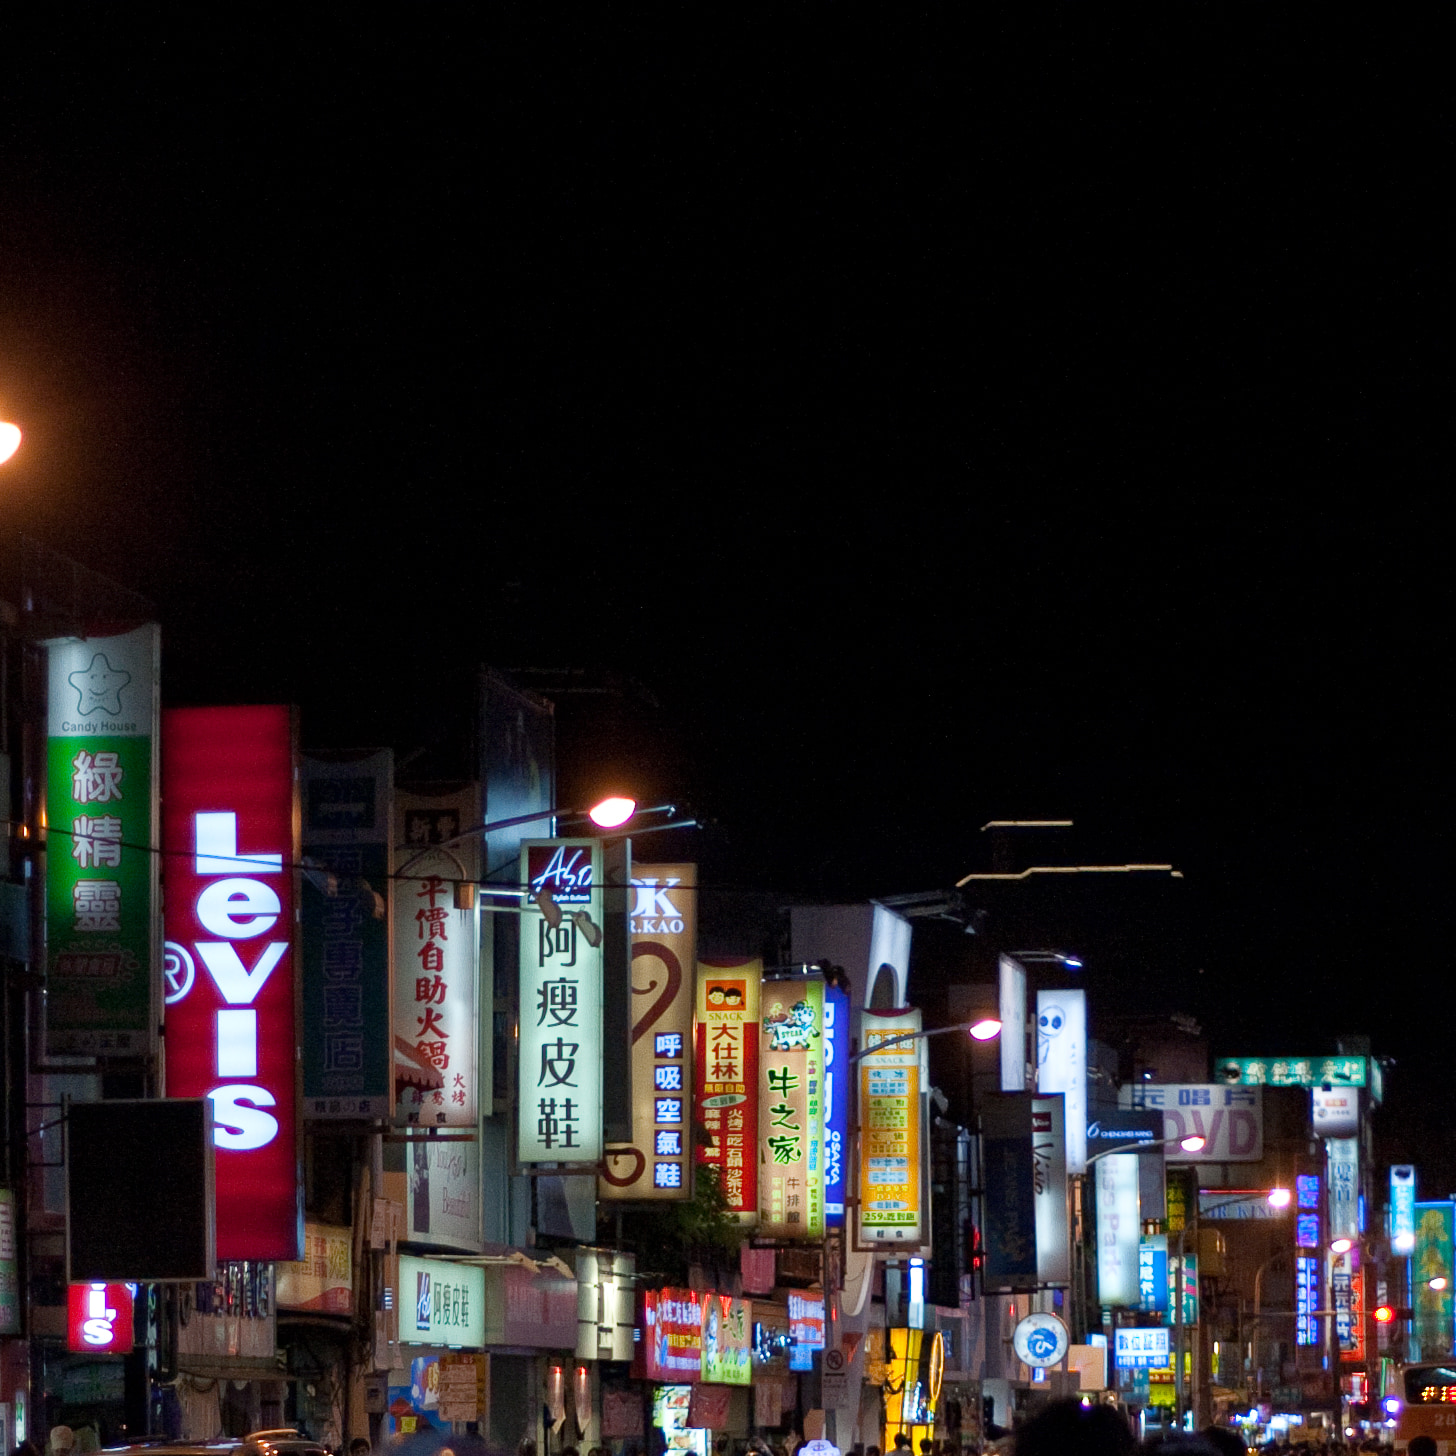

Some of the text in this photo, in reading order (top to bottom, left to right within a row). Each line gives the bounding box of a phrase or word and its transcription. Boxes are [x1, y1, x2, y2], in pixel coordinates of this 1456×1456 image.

[61, 719, 137, 734] Candy House
[537, 917, 581, 1150] 阿瘦皮鞋
[708, 1011, 743, 1021] SNACK
[655, 1033, 682, 1188] 呼吸空氣鞋
[767, 1066, 801, 1165] 牛之家
